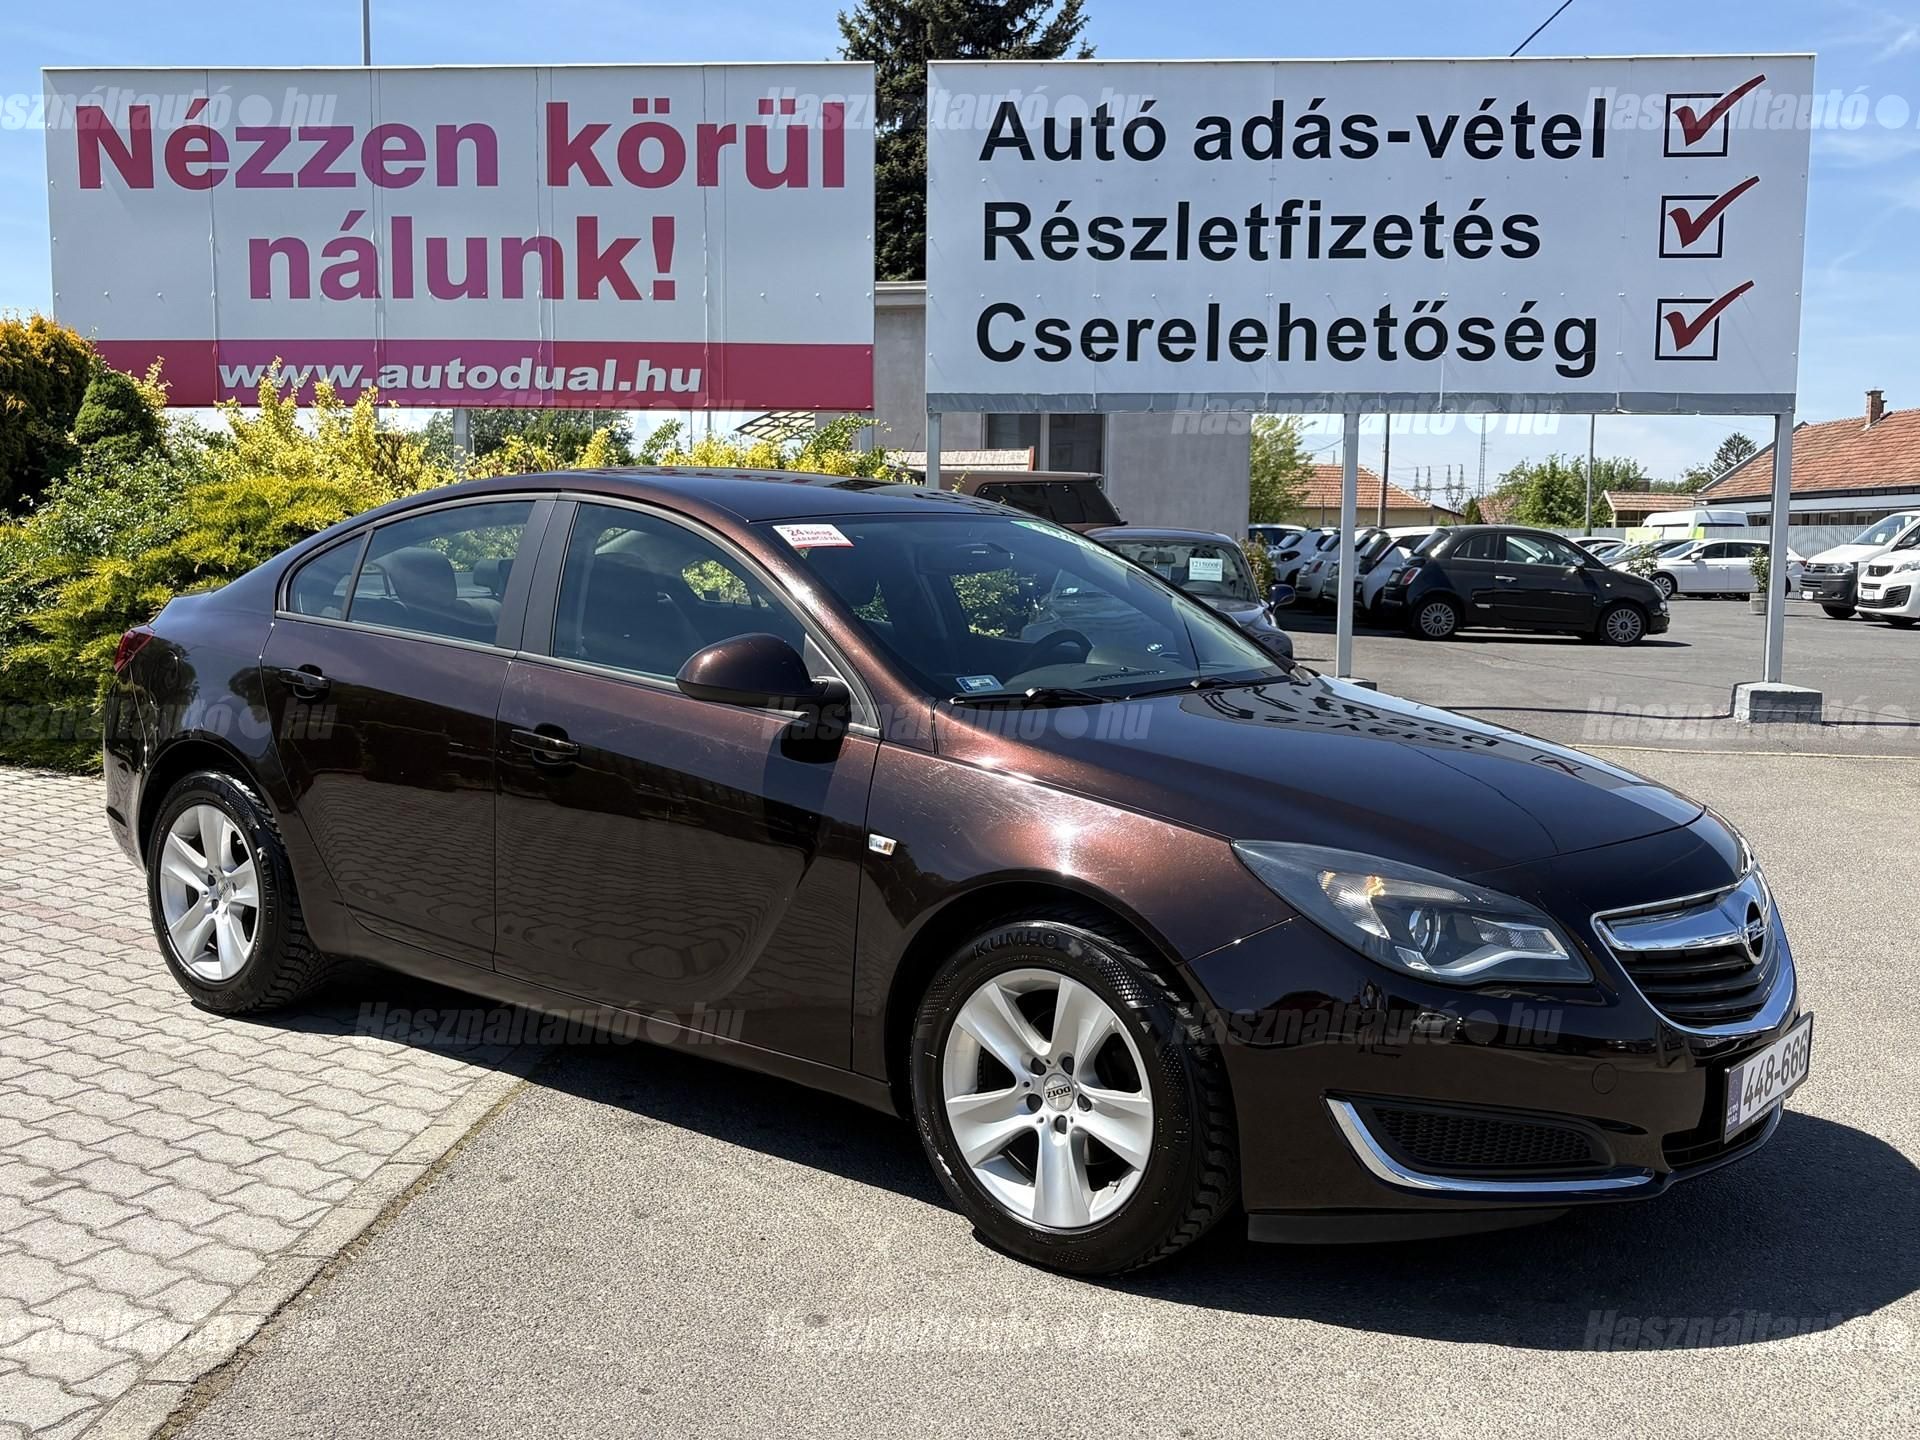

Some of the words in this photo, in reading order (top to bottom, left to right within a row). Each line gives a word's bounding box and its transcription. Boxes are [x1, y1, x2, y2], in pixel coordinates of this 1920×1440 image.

[77, 97, 498, 190] Nézzen
[547, 97, 845, 189] körül
[979, 96, 1166, 162] Autó
[1194, 96, 1606, 162] adás-vétel
[249, 210, 677, 301] nálunk!
[983, 198, 1541, 262] Részletfizetés
[219, 357, 702, 393] www.autodual.hu
[976, 300, 1598, 379] Cserelehetőség
[1743, 1028, 1808, 1112] 448-666
